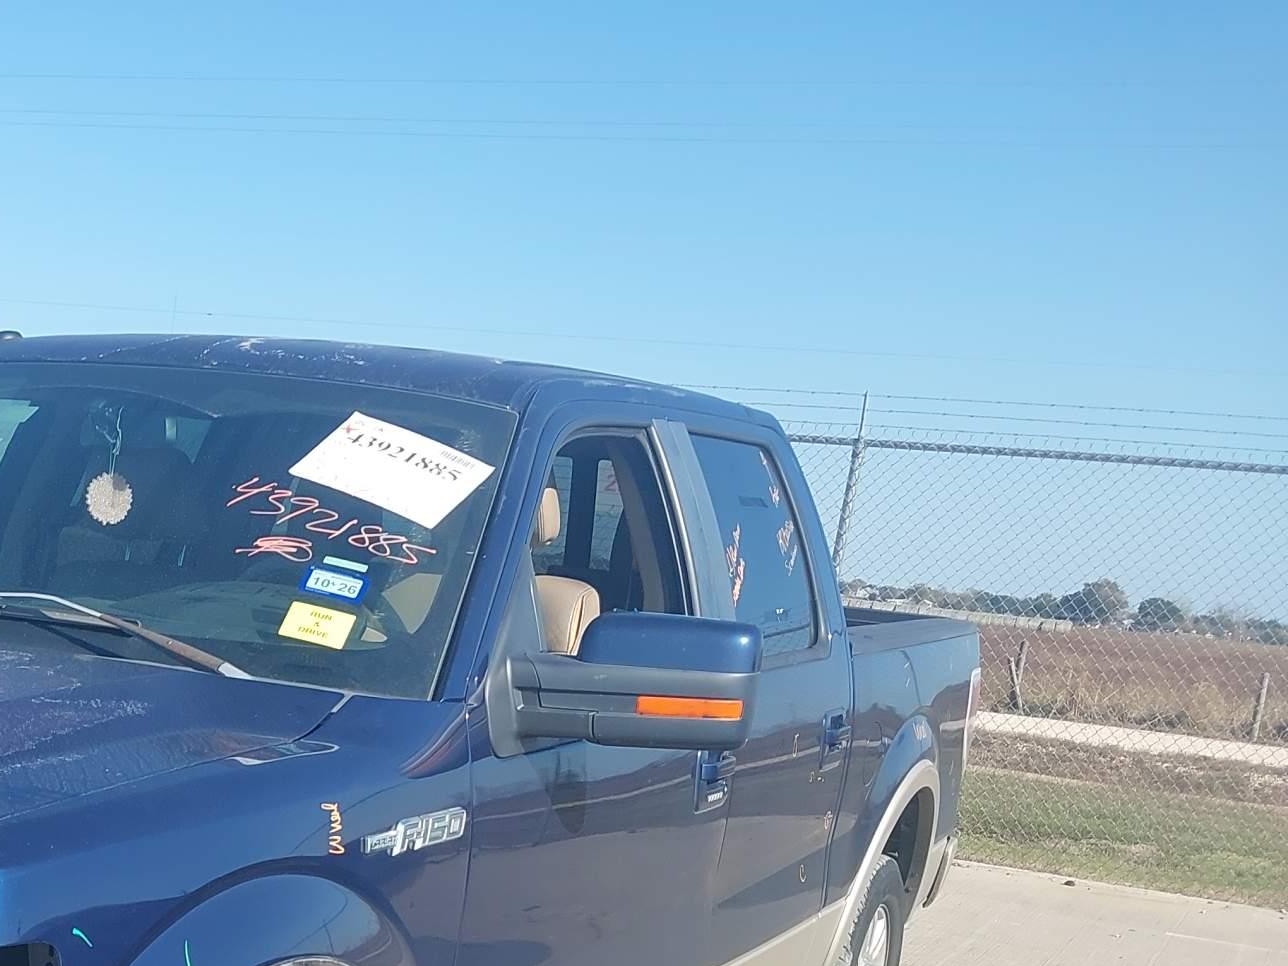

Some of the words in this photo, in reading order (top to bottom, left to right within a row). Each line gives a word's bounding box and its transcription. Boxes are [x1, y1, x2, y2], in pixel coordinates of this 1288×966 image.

[347, 432, 463, 483] 43921885
[226, 475, 437, 565] 43921885
[337, 582, 358, 595] 26
[310, 610, 333, 621] RUN
[297, 626, 329, 638] DRIVE
